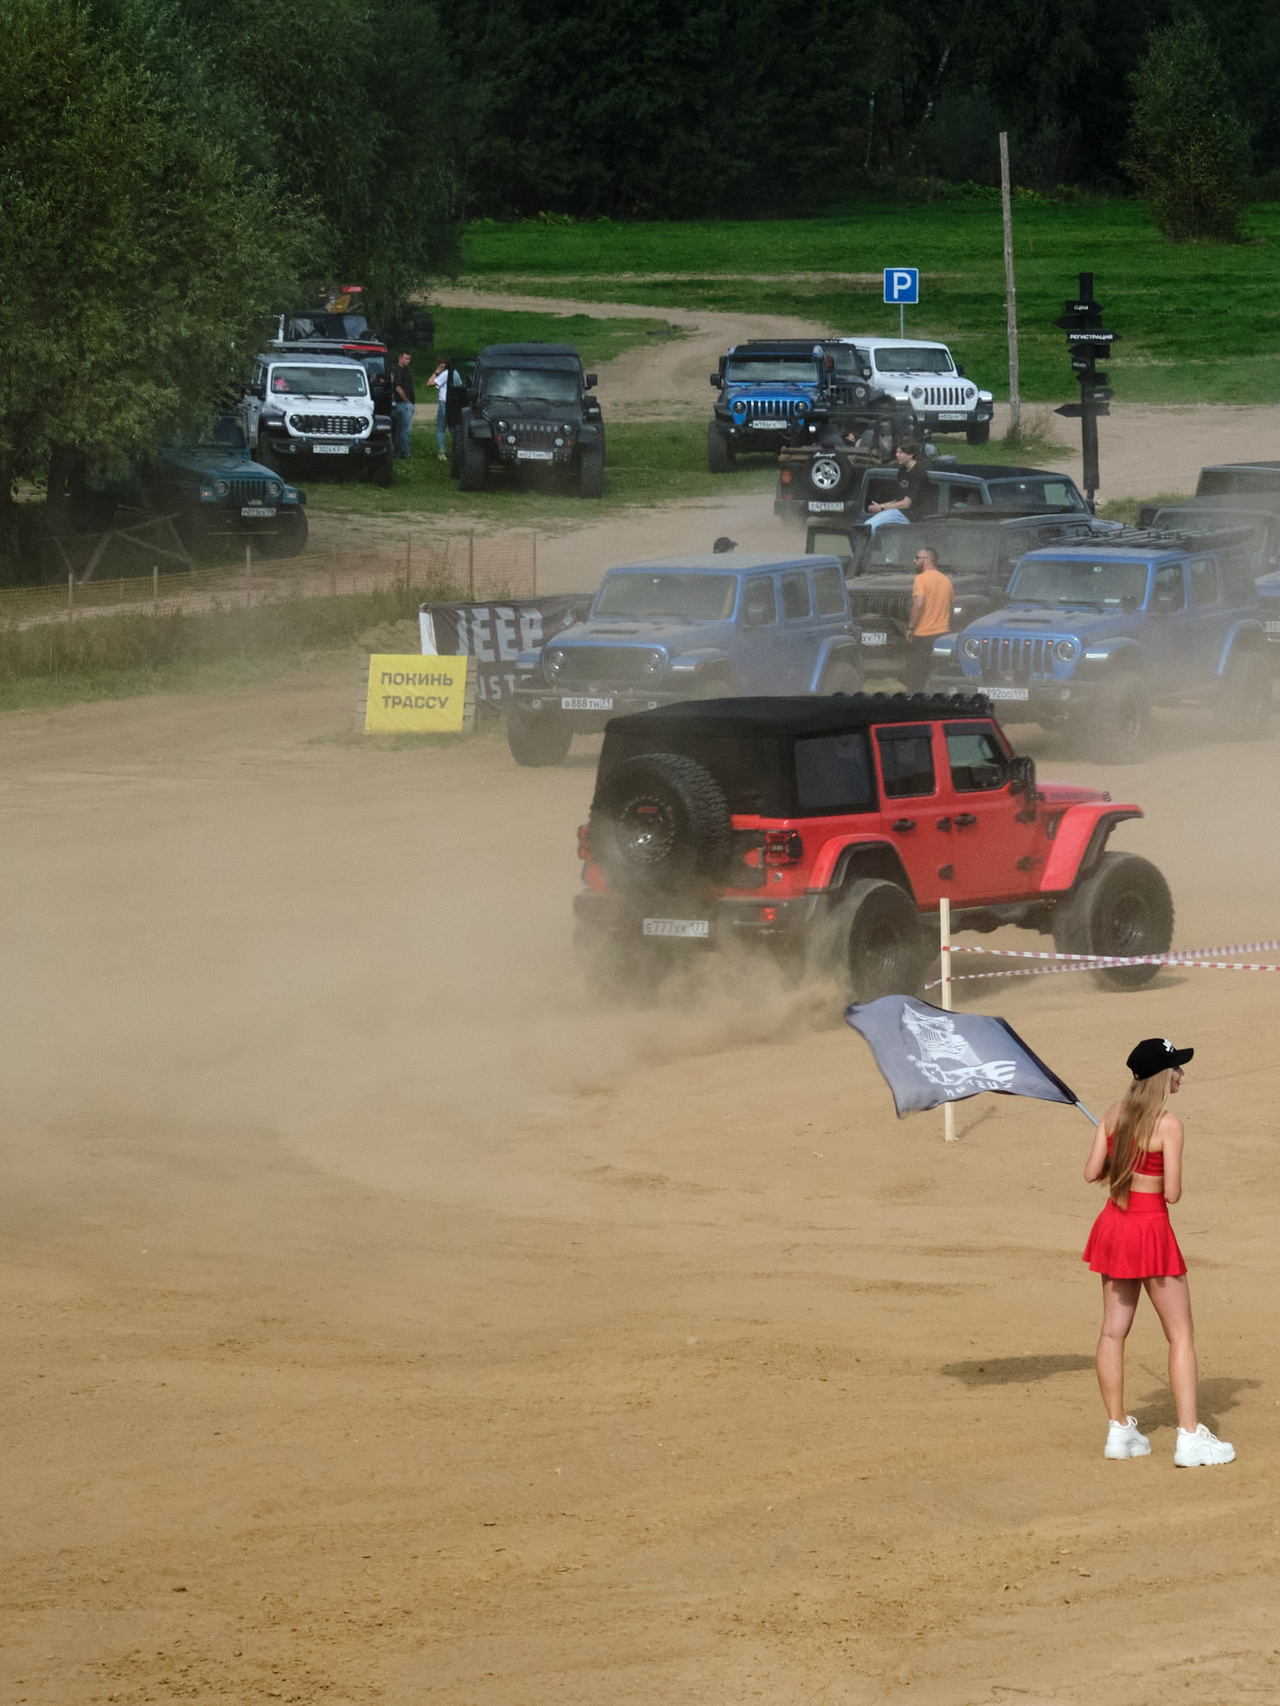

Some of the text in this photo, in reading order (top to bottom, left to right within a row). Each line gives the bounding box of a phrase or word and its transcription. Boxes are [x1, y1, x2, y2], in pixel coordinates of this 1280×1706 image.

[893, 271, 912, 299] P
[1069, 333, 1113, 341] РЕГИСТРАЦИЯ
[380, 671, 454, 687] ПОКИНЬ
[382, 695, 450, 710] ТРАССУ
